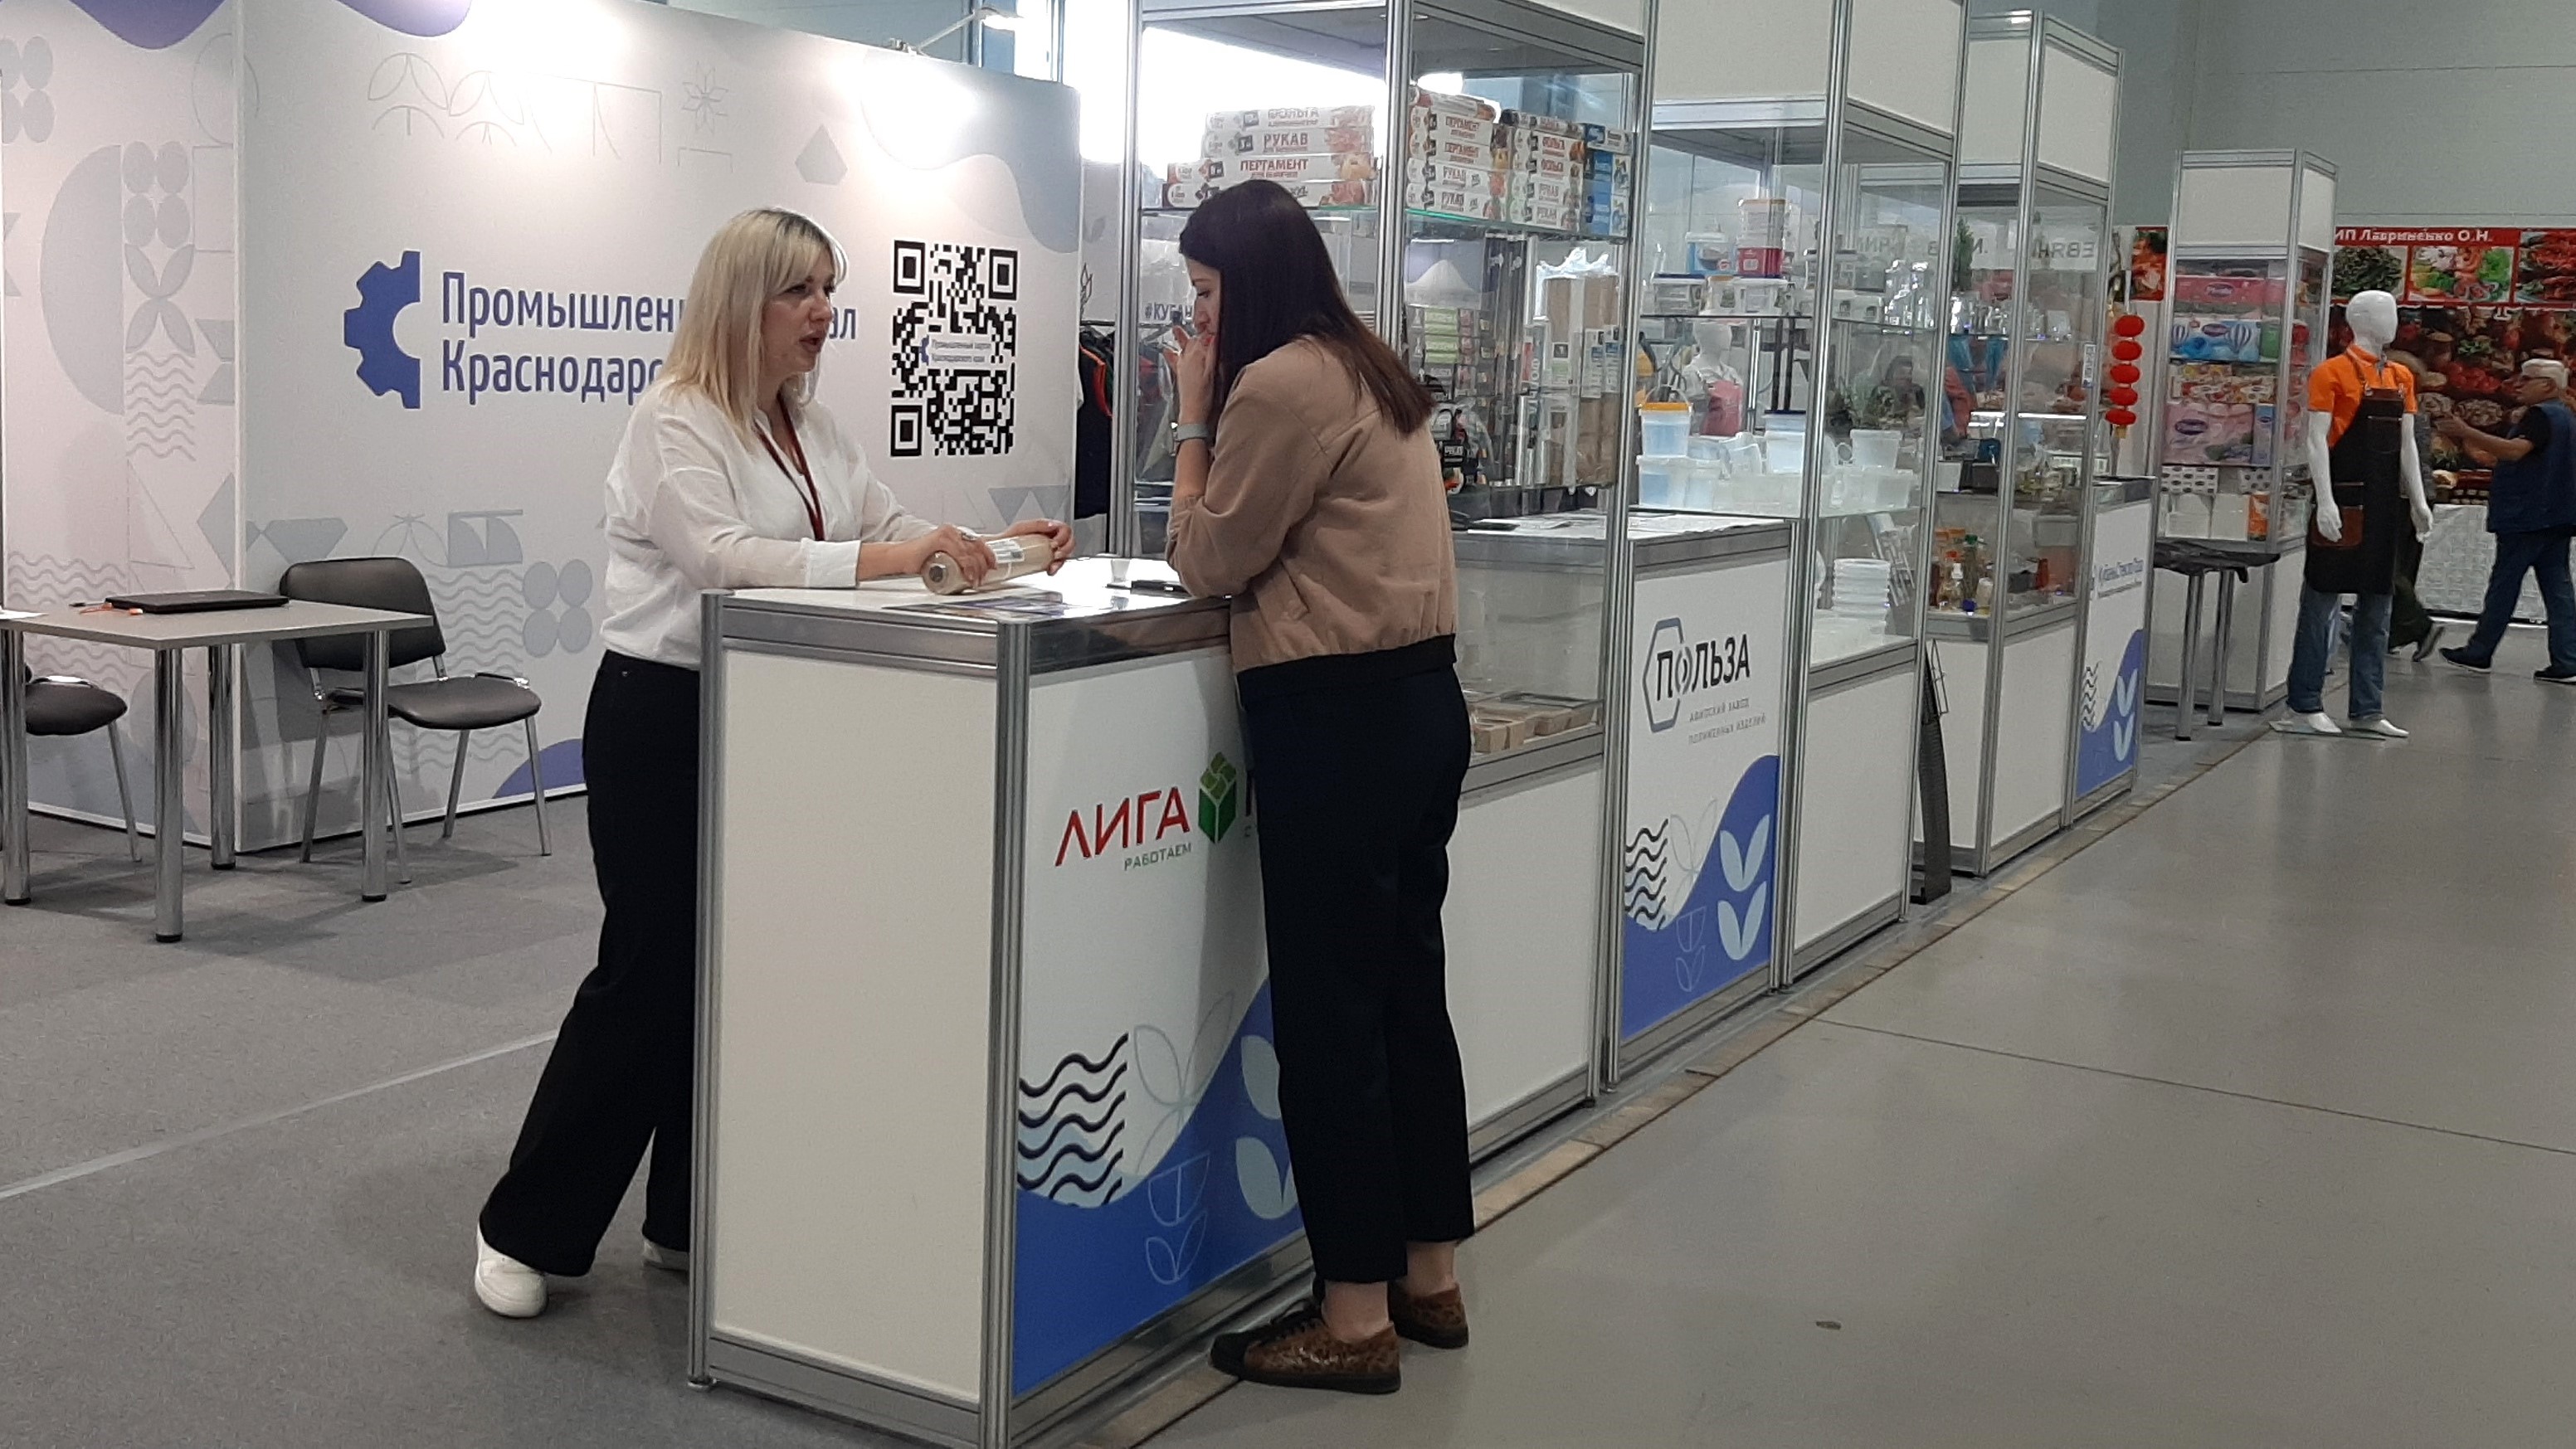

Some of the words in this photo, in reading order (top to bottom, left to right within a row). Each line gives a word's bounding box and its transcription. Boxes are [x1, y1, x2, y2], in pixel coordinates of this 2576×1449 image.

[1264, 133, 1308, 147] РУКАВ
[442, 271, 685, 338] Промышлен
[1657, 634, 1751, 701] ПОЛЬЗА
[1054, 785, 1191, 867] ЛИГА
[1123, 842, 1192, 872] РАБОТАЕМ
